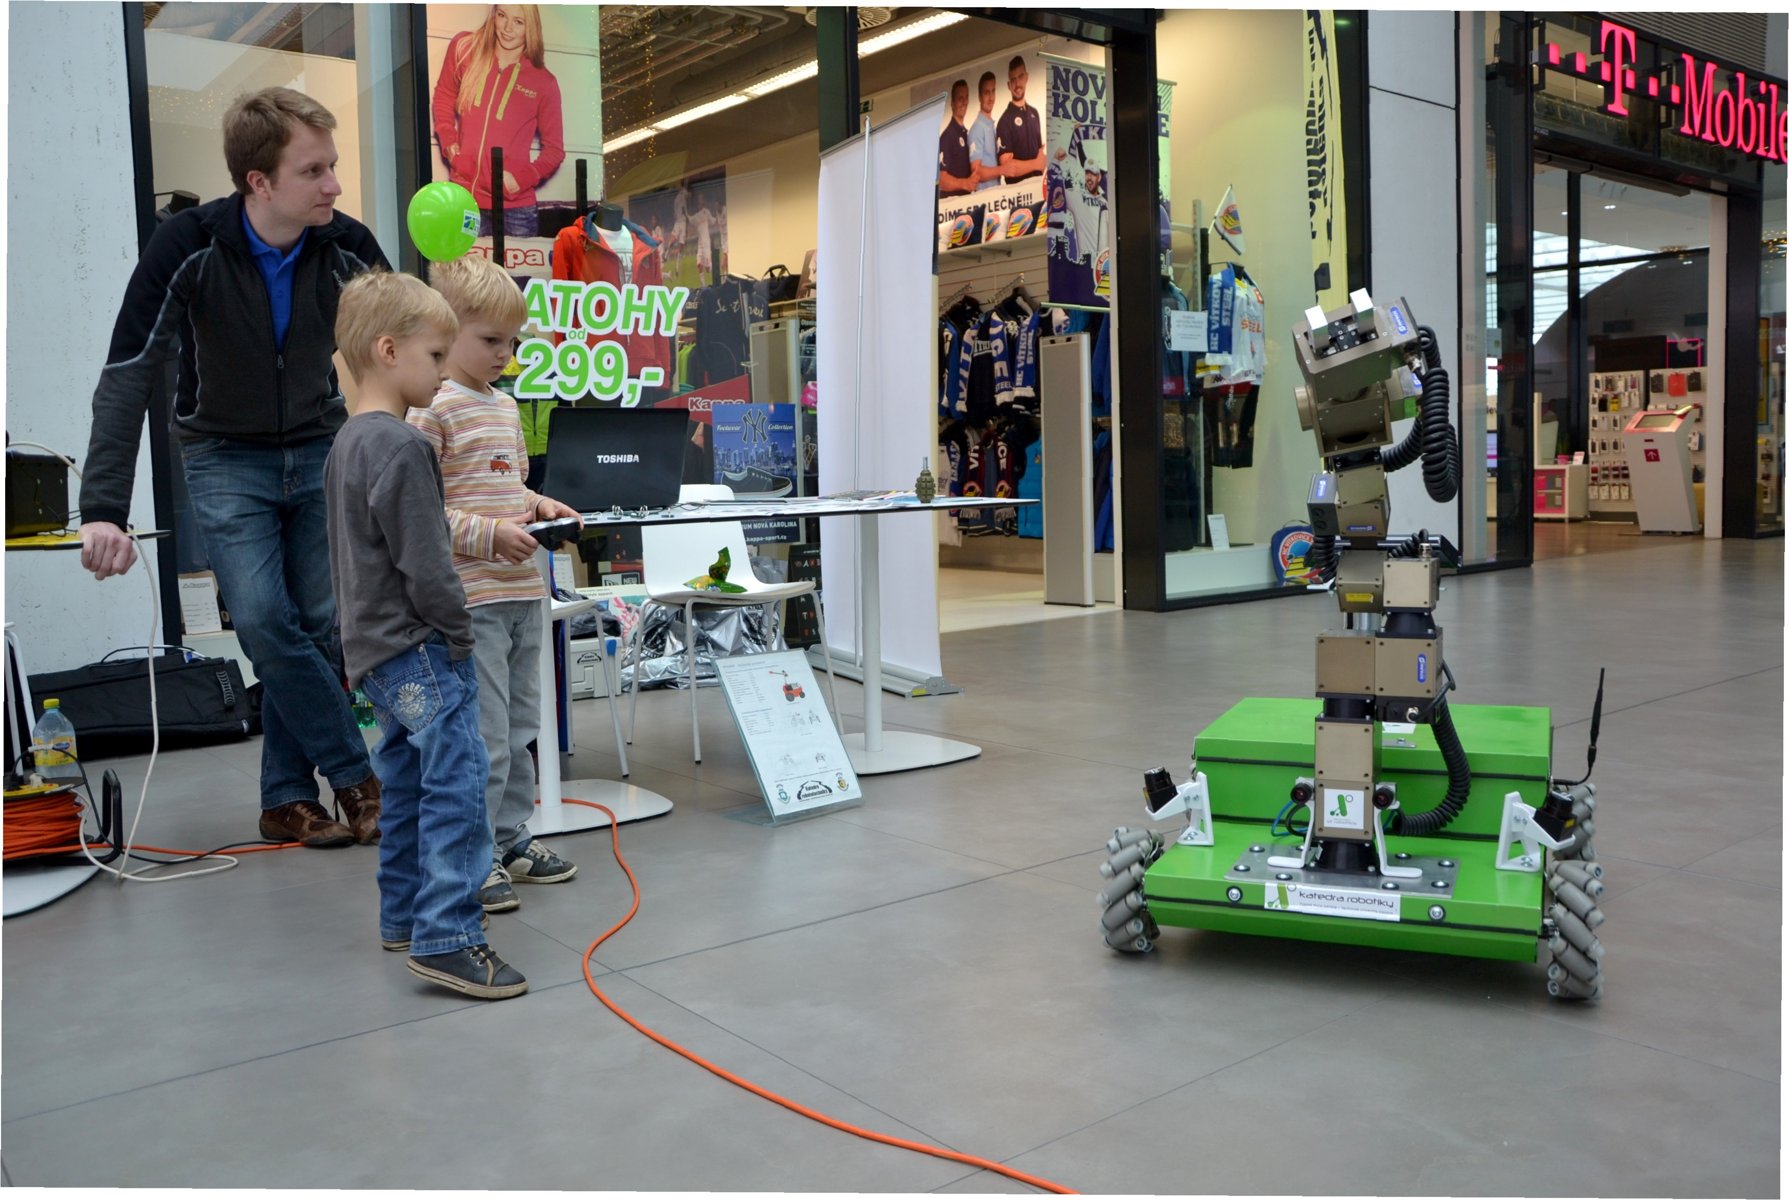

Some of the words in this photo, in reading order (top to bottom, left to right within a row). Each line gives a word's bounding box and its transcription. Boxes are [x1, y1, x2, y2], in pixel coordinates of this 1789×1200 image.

[1051, 65, 1106, 100] NOV
[568, 327, 586, 341] od
[597, 454, 640, 464] TOSHIBA
[769, 521, 798, 529] KAROLINA
[1299, 891, 1345, 902] katedra
[1346, 896, 1394, 908] robotiky
